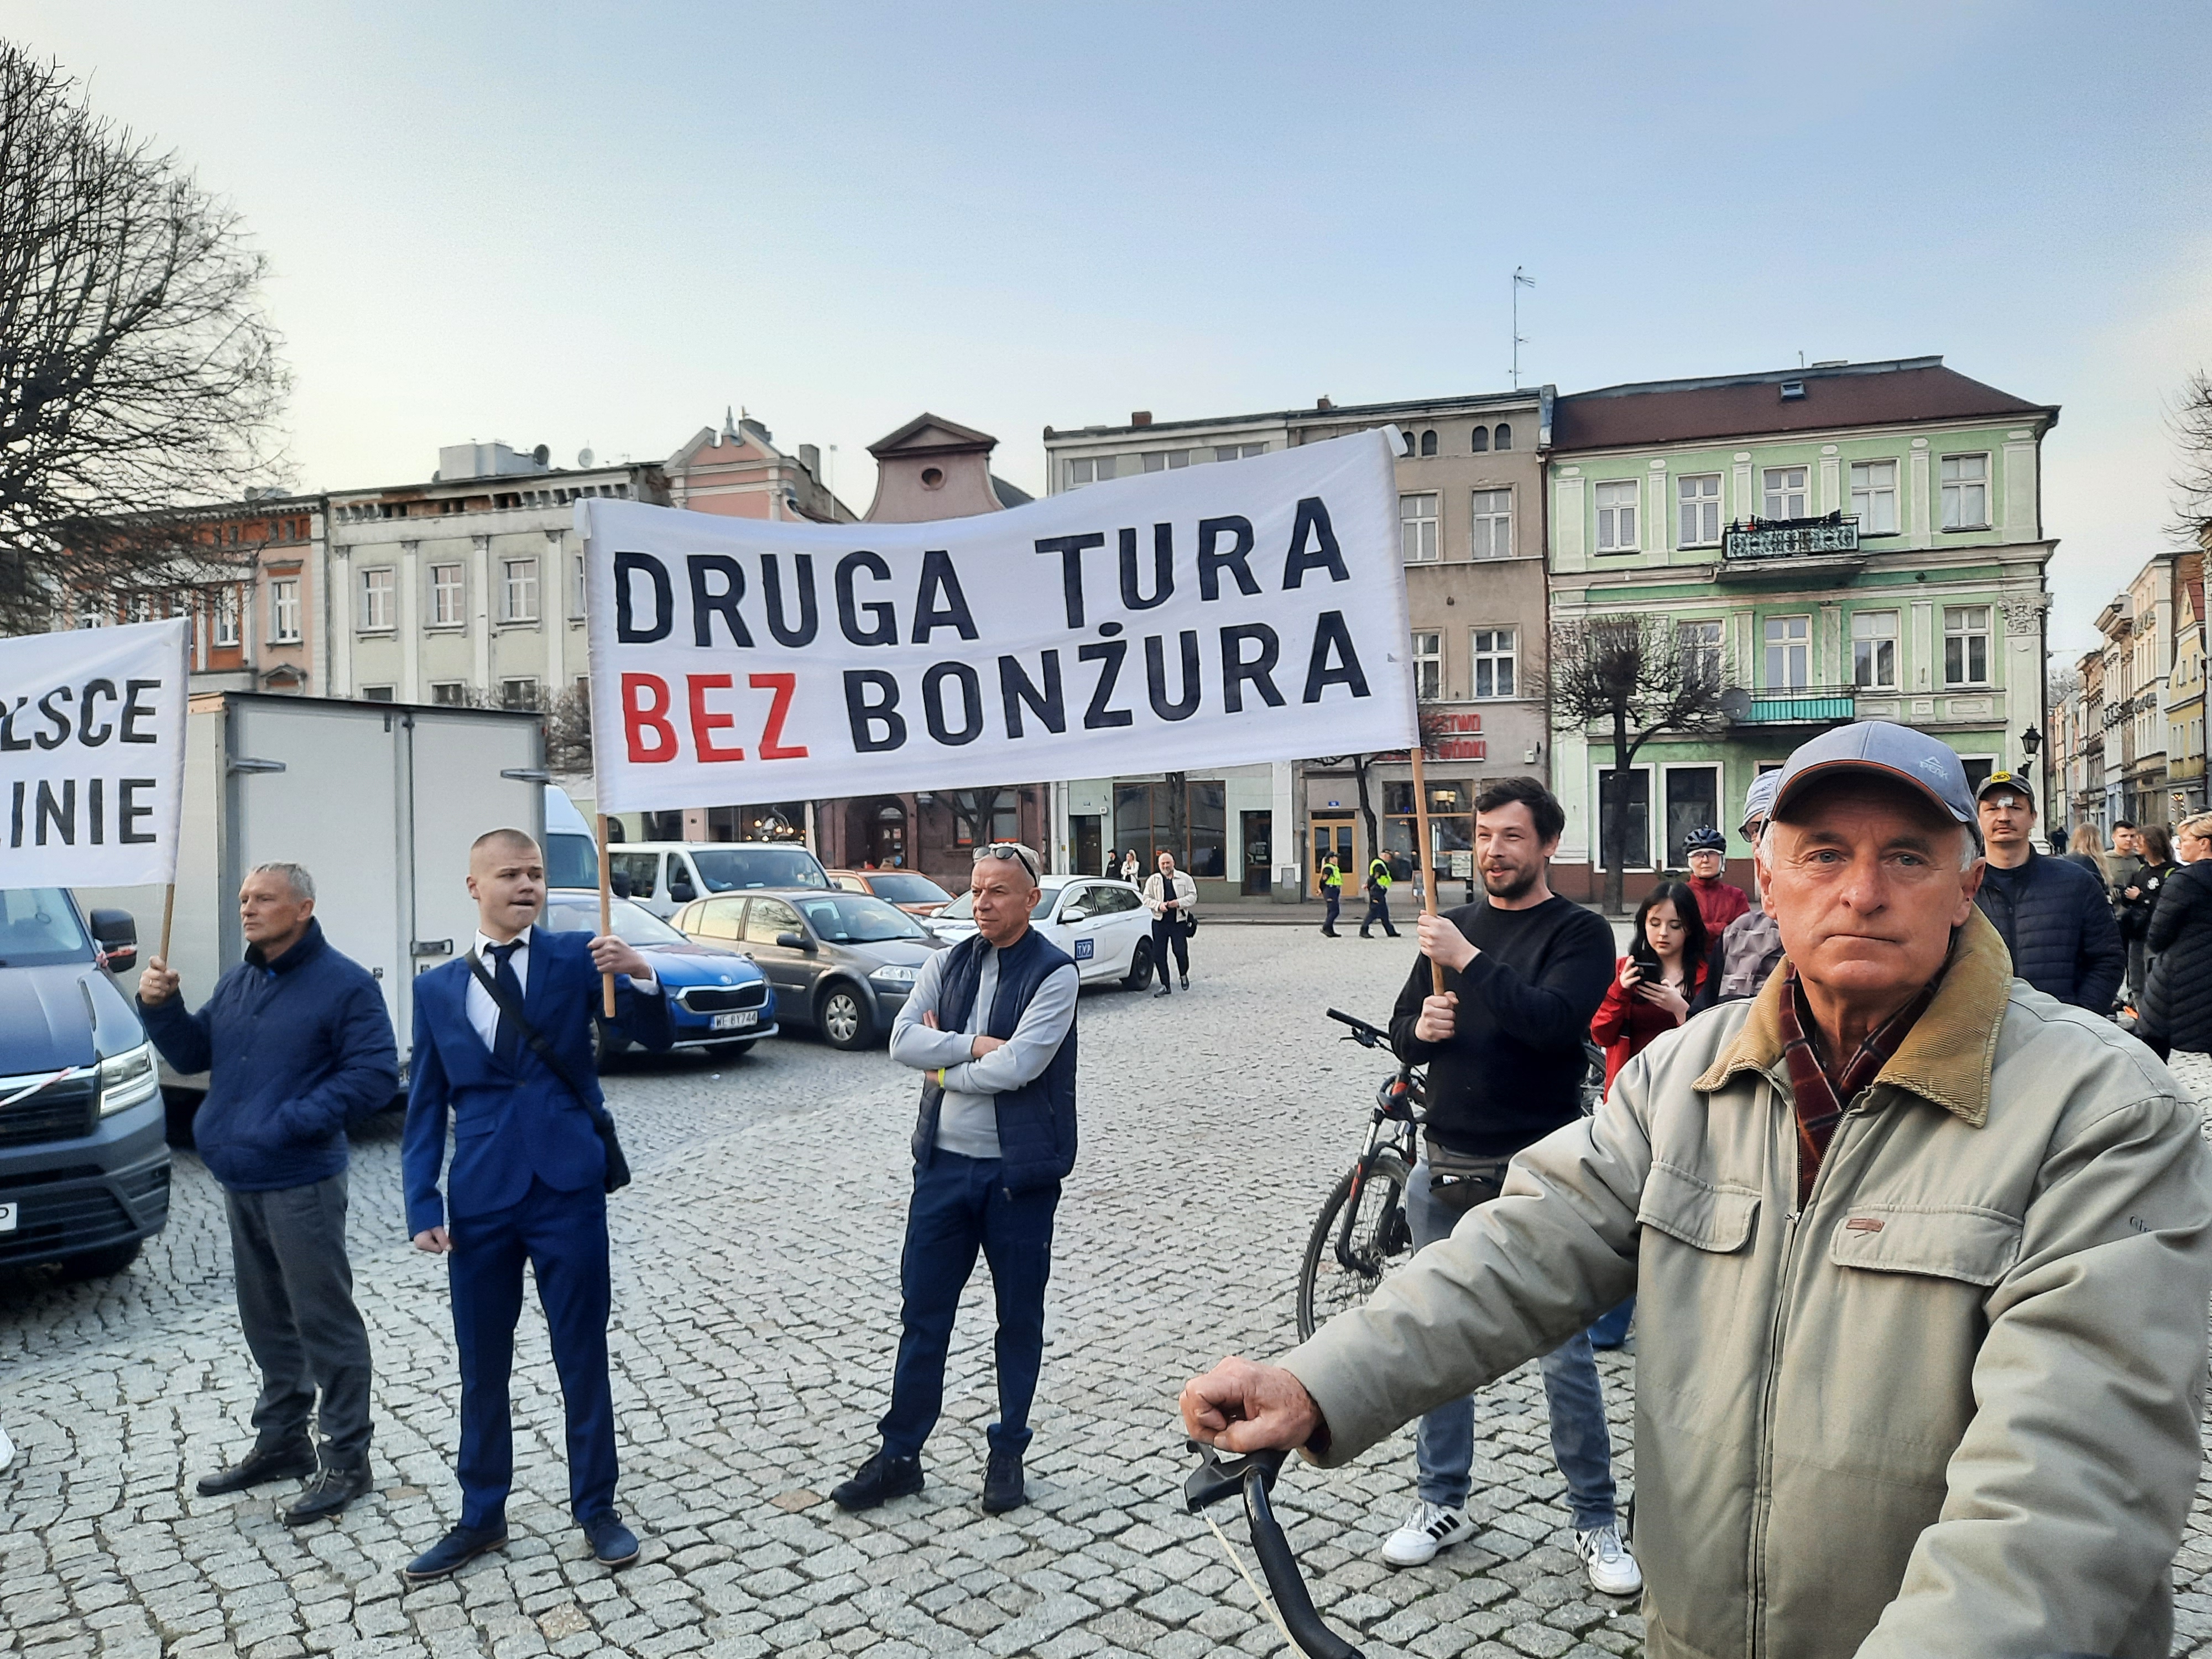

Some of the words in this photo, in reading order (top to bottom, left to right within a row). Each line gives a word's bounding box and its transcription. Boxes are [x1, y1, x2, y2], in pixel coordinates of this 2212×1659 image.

[614, 550, 979, 648] DRUGA
[1034, 496, 1350, 629] TURA
[0, 679, 161, 752] LSCE
[622, 672, 809, 763] BEZ
[843, 610, 1371, 753] BONŻURA
[0, 779, 156, 848] INIE
[1077, 943, 1092, 956] TVP
